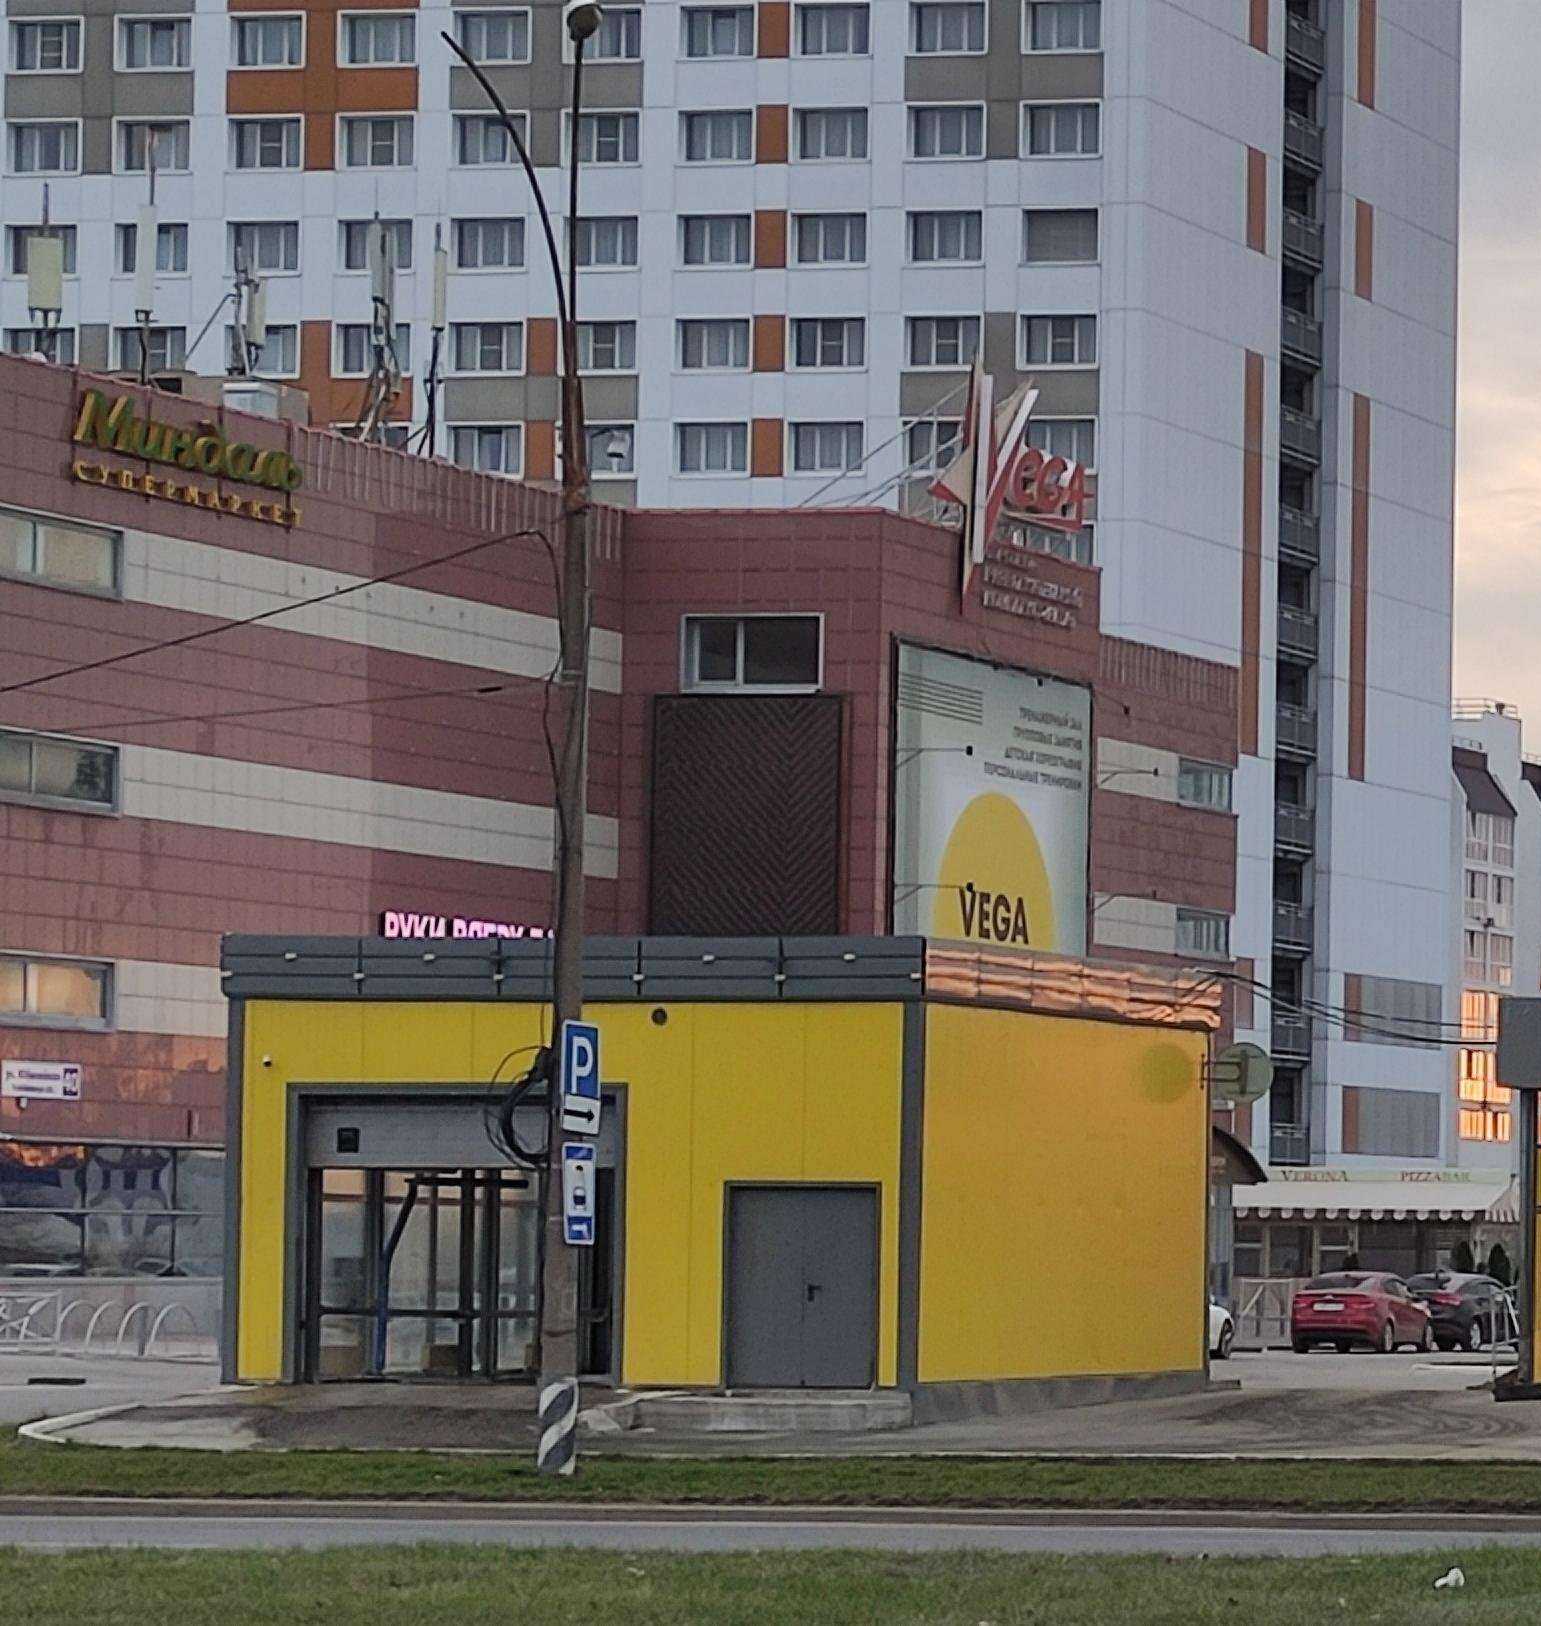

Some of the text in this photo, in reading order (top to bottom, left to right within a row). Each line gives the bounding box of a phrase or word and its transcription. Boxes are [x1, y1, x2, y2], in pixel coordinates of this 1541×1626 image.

[73, 460, 303, 526] СУПЕРМАРКЕТ
[959, 887, 1029, 944] VEGA
[1281, 1169, 1349, 1183] VERONA
